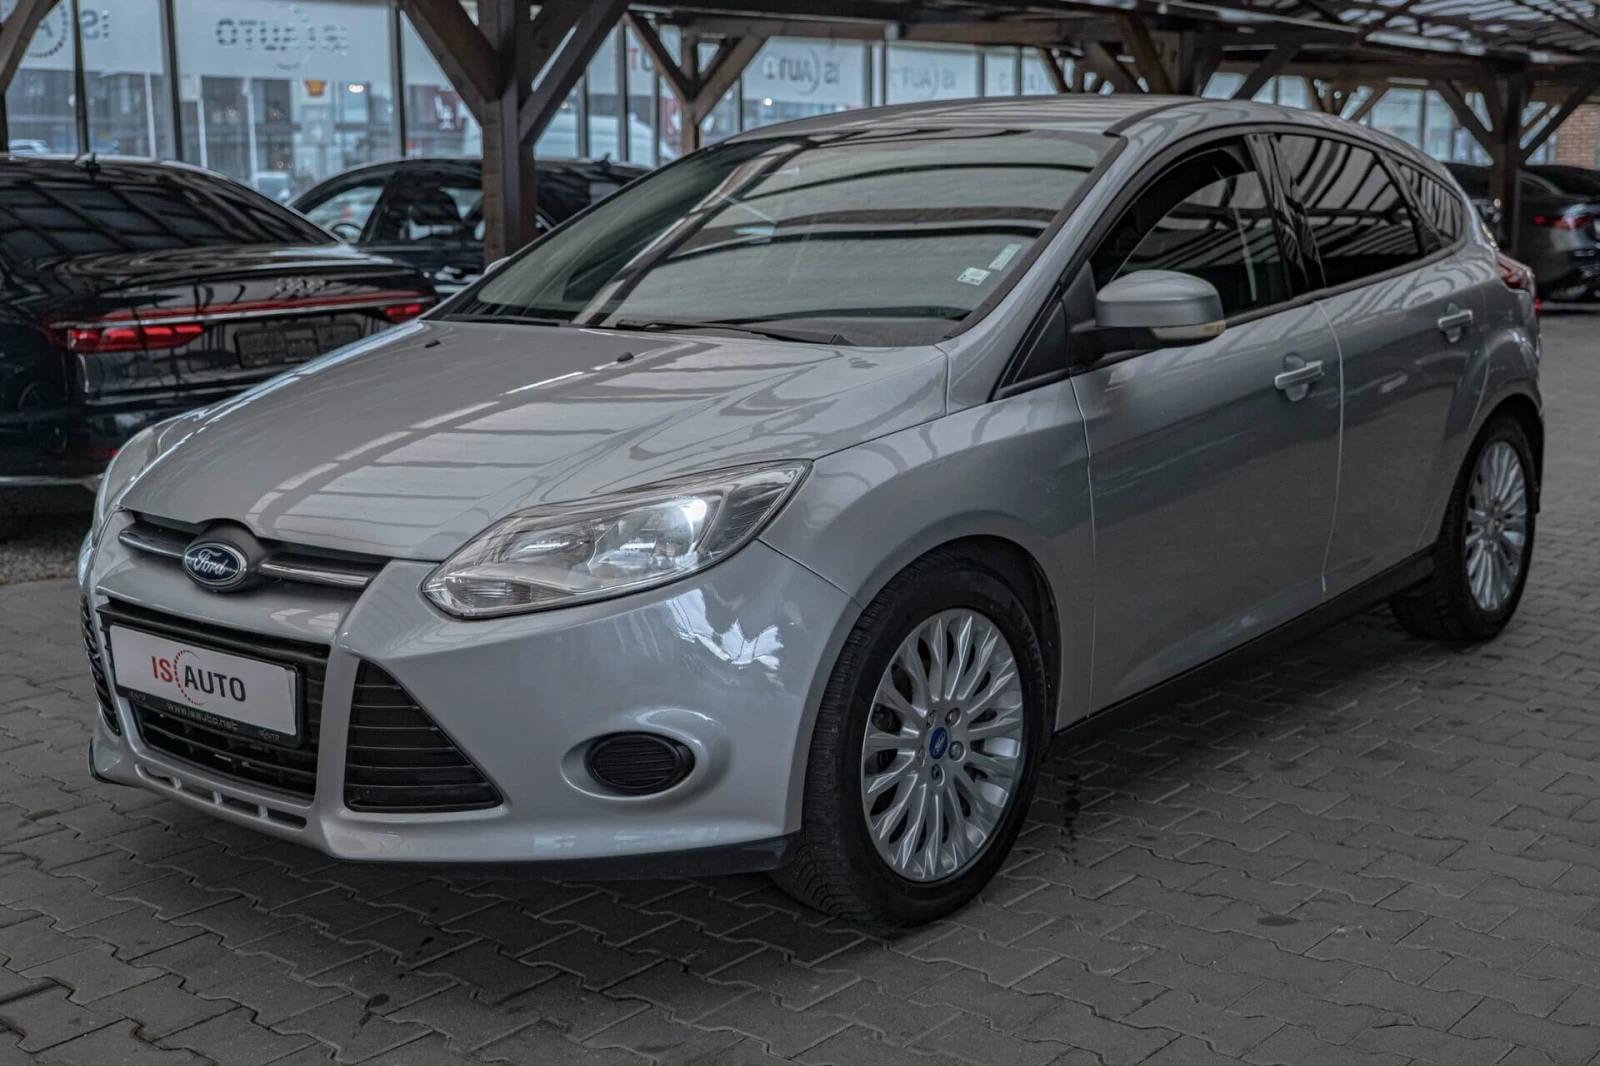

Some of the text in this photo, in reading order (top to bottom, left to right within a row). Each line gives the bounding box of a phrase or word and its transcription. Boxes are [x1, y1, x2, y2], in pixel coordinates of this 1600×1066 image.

[193, 548, 229, 575] Ford
[151, 656, 246, 702] IS AUTO
